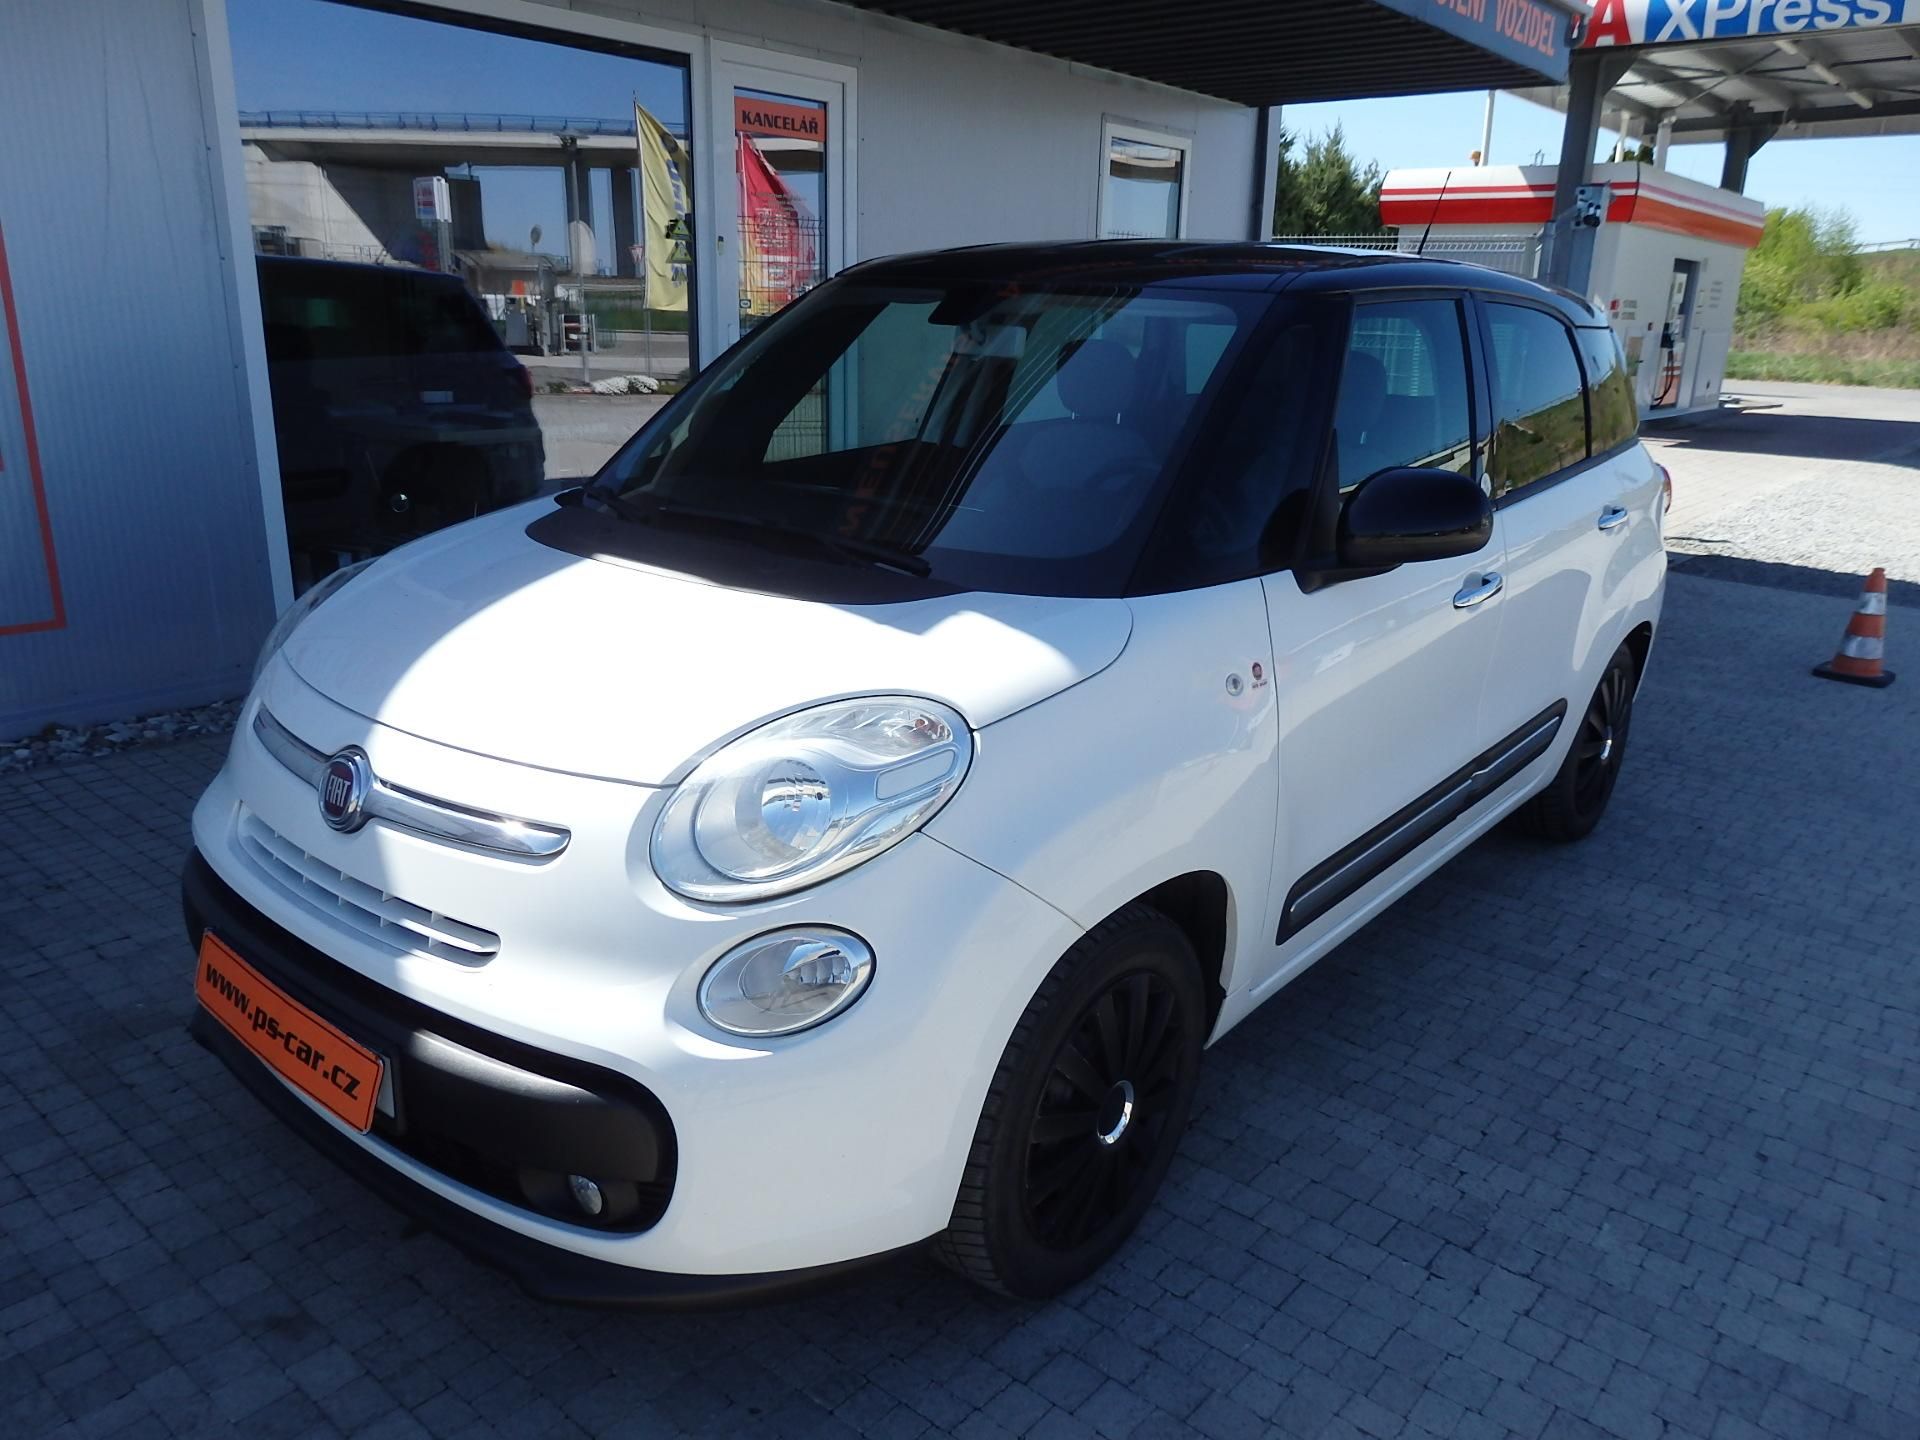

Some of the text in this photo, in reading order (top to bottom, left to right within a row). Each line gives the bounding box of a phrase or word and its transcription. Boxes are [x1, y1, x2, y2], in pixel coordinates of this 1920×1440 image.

[1495, 0, 1556, 57] VOZIDEL
[742, 110, 819, 134] KANCELÁŘ
[326, 774, 352, 808] FIAT
[206, 963, 361, 1101] www.ps-car.cz
